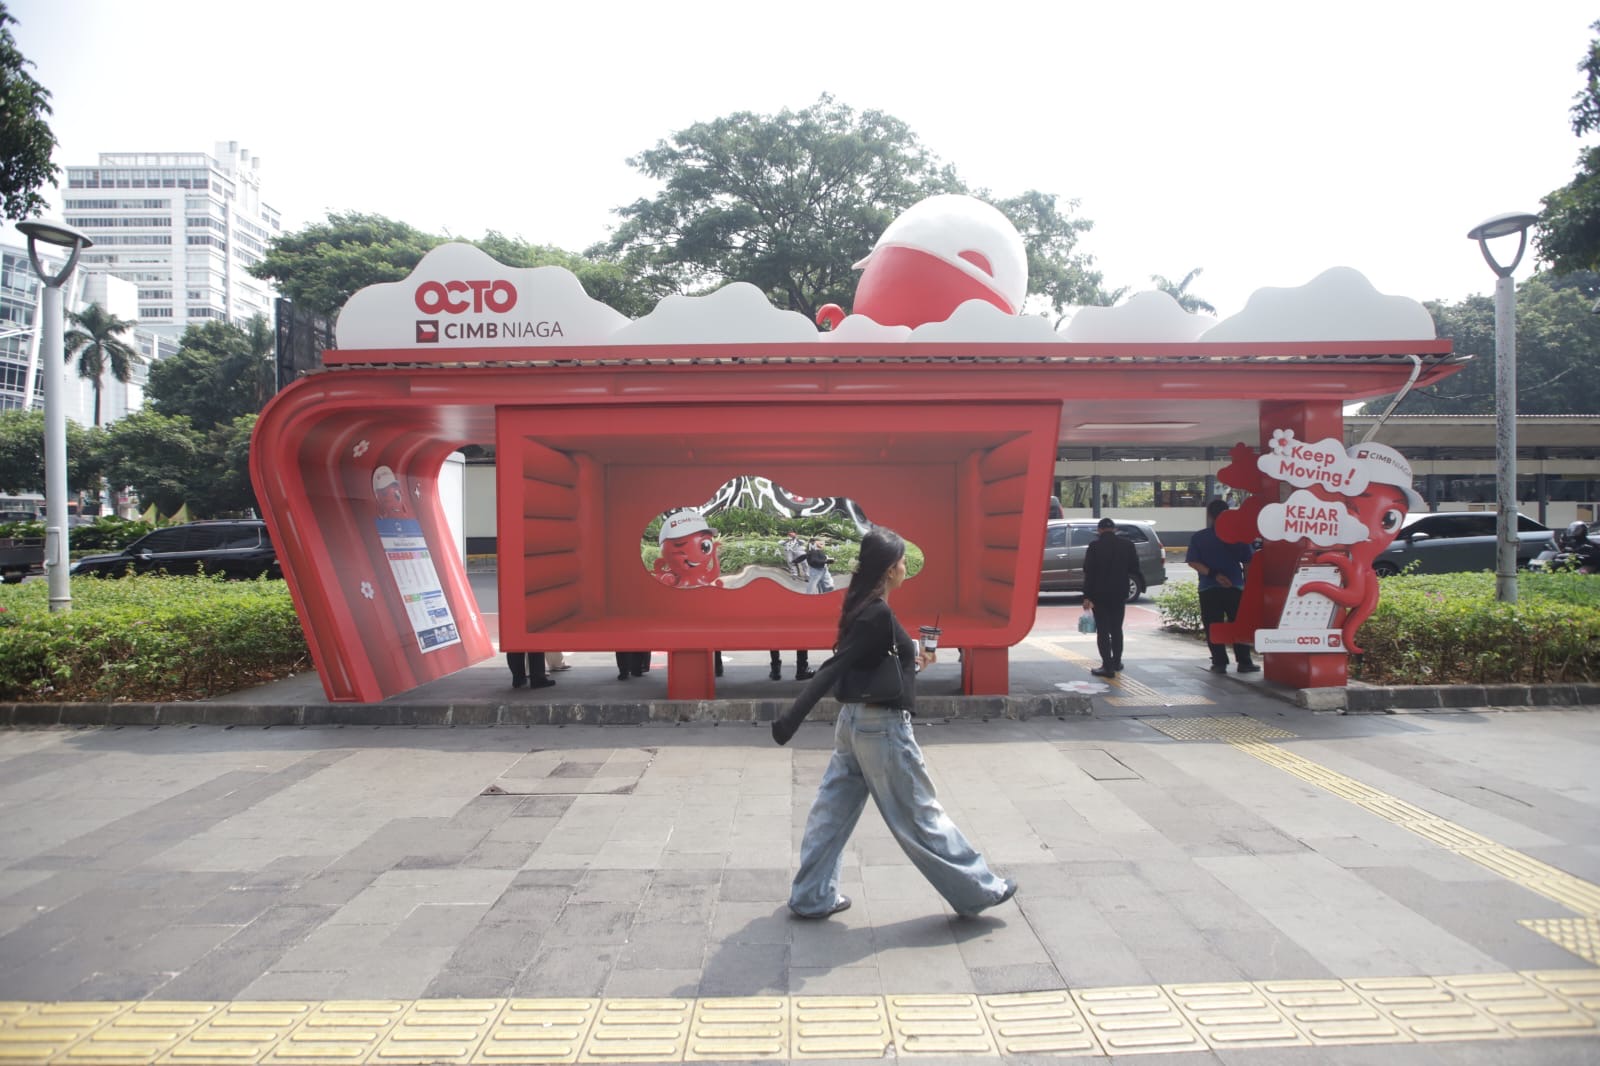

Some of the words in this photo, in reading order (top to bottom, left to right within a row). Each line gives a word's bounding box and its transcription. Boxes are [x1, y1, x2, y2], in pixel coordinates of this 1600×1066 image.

[415, 280, 518, 315] OCTO
[444, 322, 498, 339] CIMB
[502, 321, 564, 338] NIAGA
[1291, 445, 1335, 465] Keep
[1369, 452, 1392, 464] CIMB
[1286, 505, 1338, 522] KEJAR
[1284, 519, 1338, 537] MIMPI!
[1296, 636, 1321, 645] OCTO
